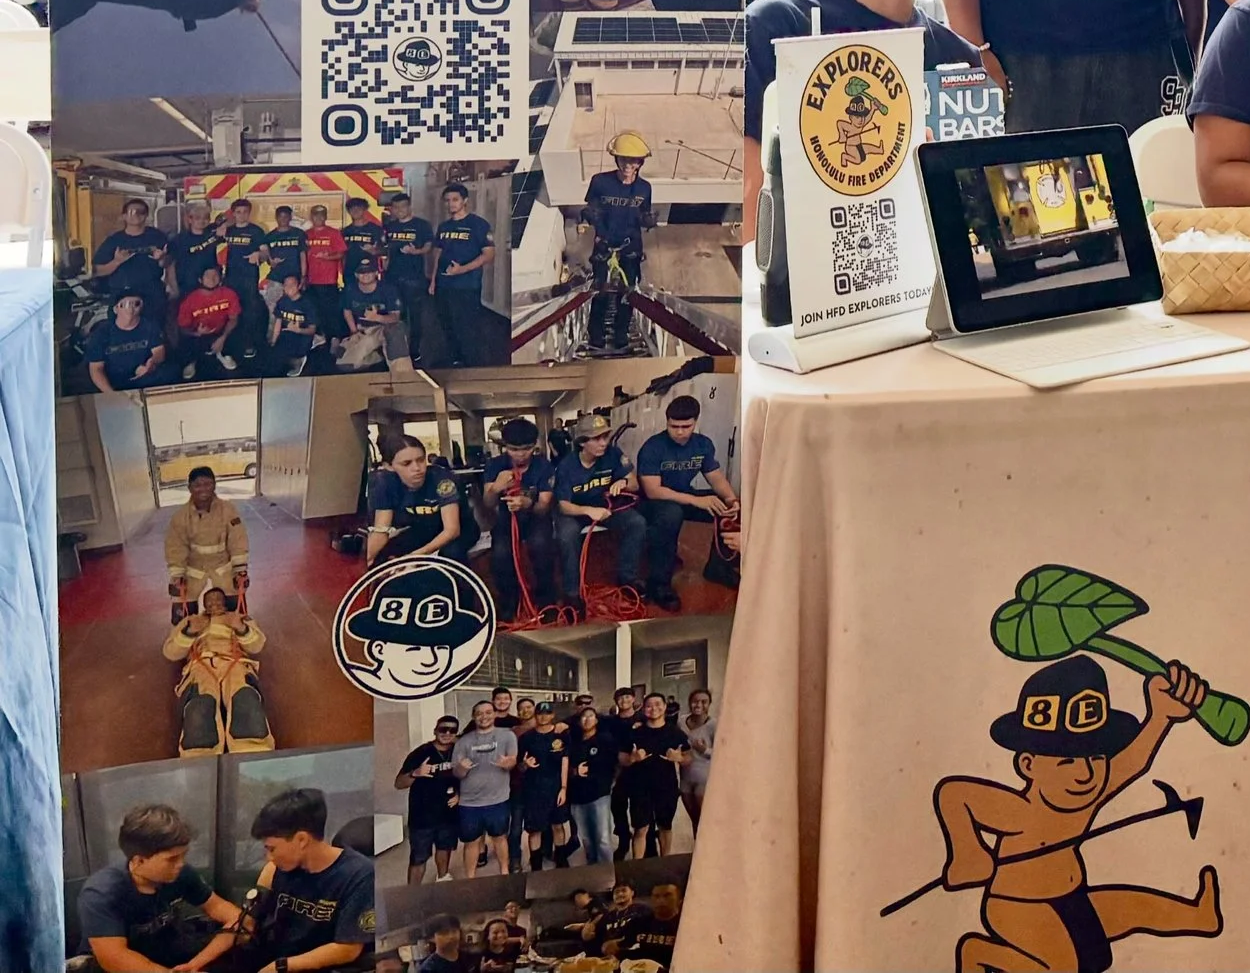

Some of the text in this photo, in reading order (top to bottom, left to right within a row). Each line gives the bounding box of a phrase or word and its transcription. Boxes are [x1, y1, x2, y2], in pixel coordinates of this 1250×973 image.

[807, 50, 903, 111] EXPLORERS
[941, 73, 986, 83] KIRKLAND
[939, 88, 1005, 116] NUT
[810, 121, 906, 187] HONOLULU FIRE DEPARTMENT
[801, 311, 823, 326] JOIN
[826, 305, 846, 319] HFD
[848, 293, 901, 314] EXPLORERS
[381, 600, 445, 623] 8 E
[1027, 699, 1098, 726] 8 E
